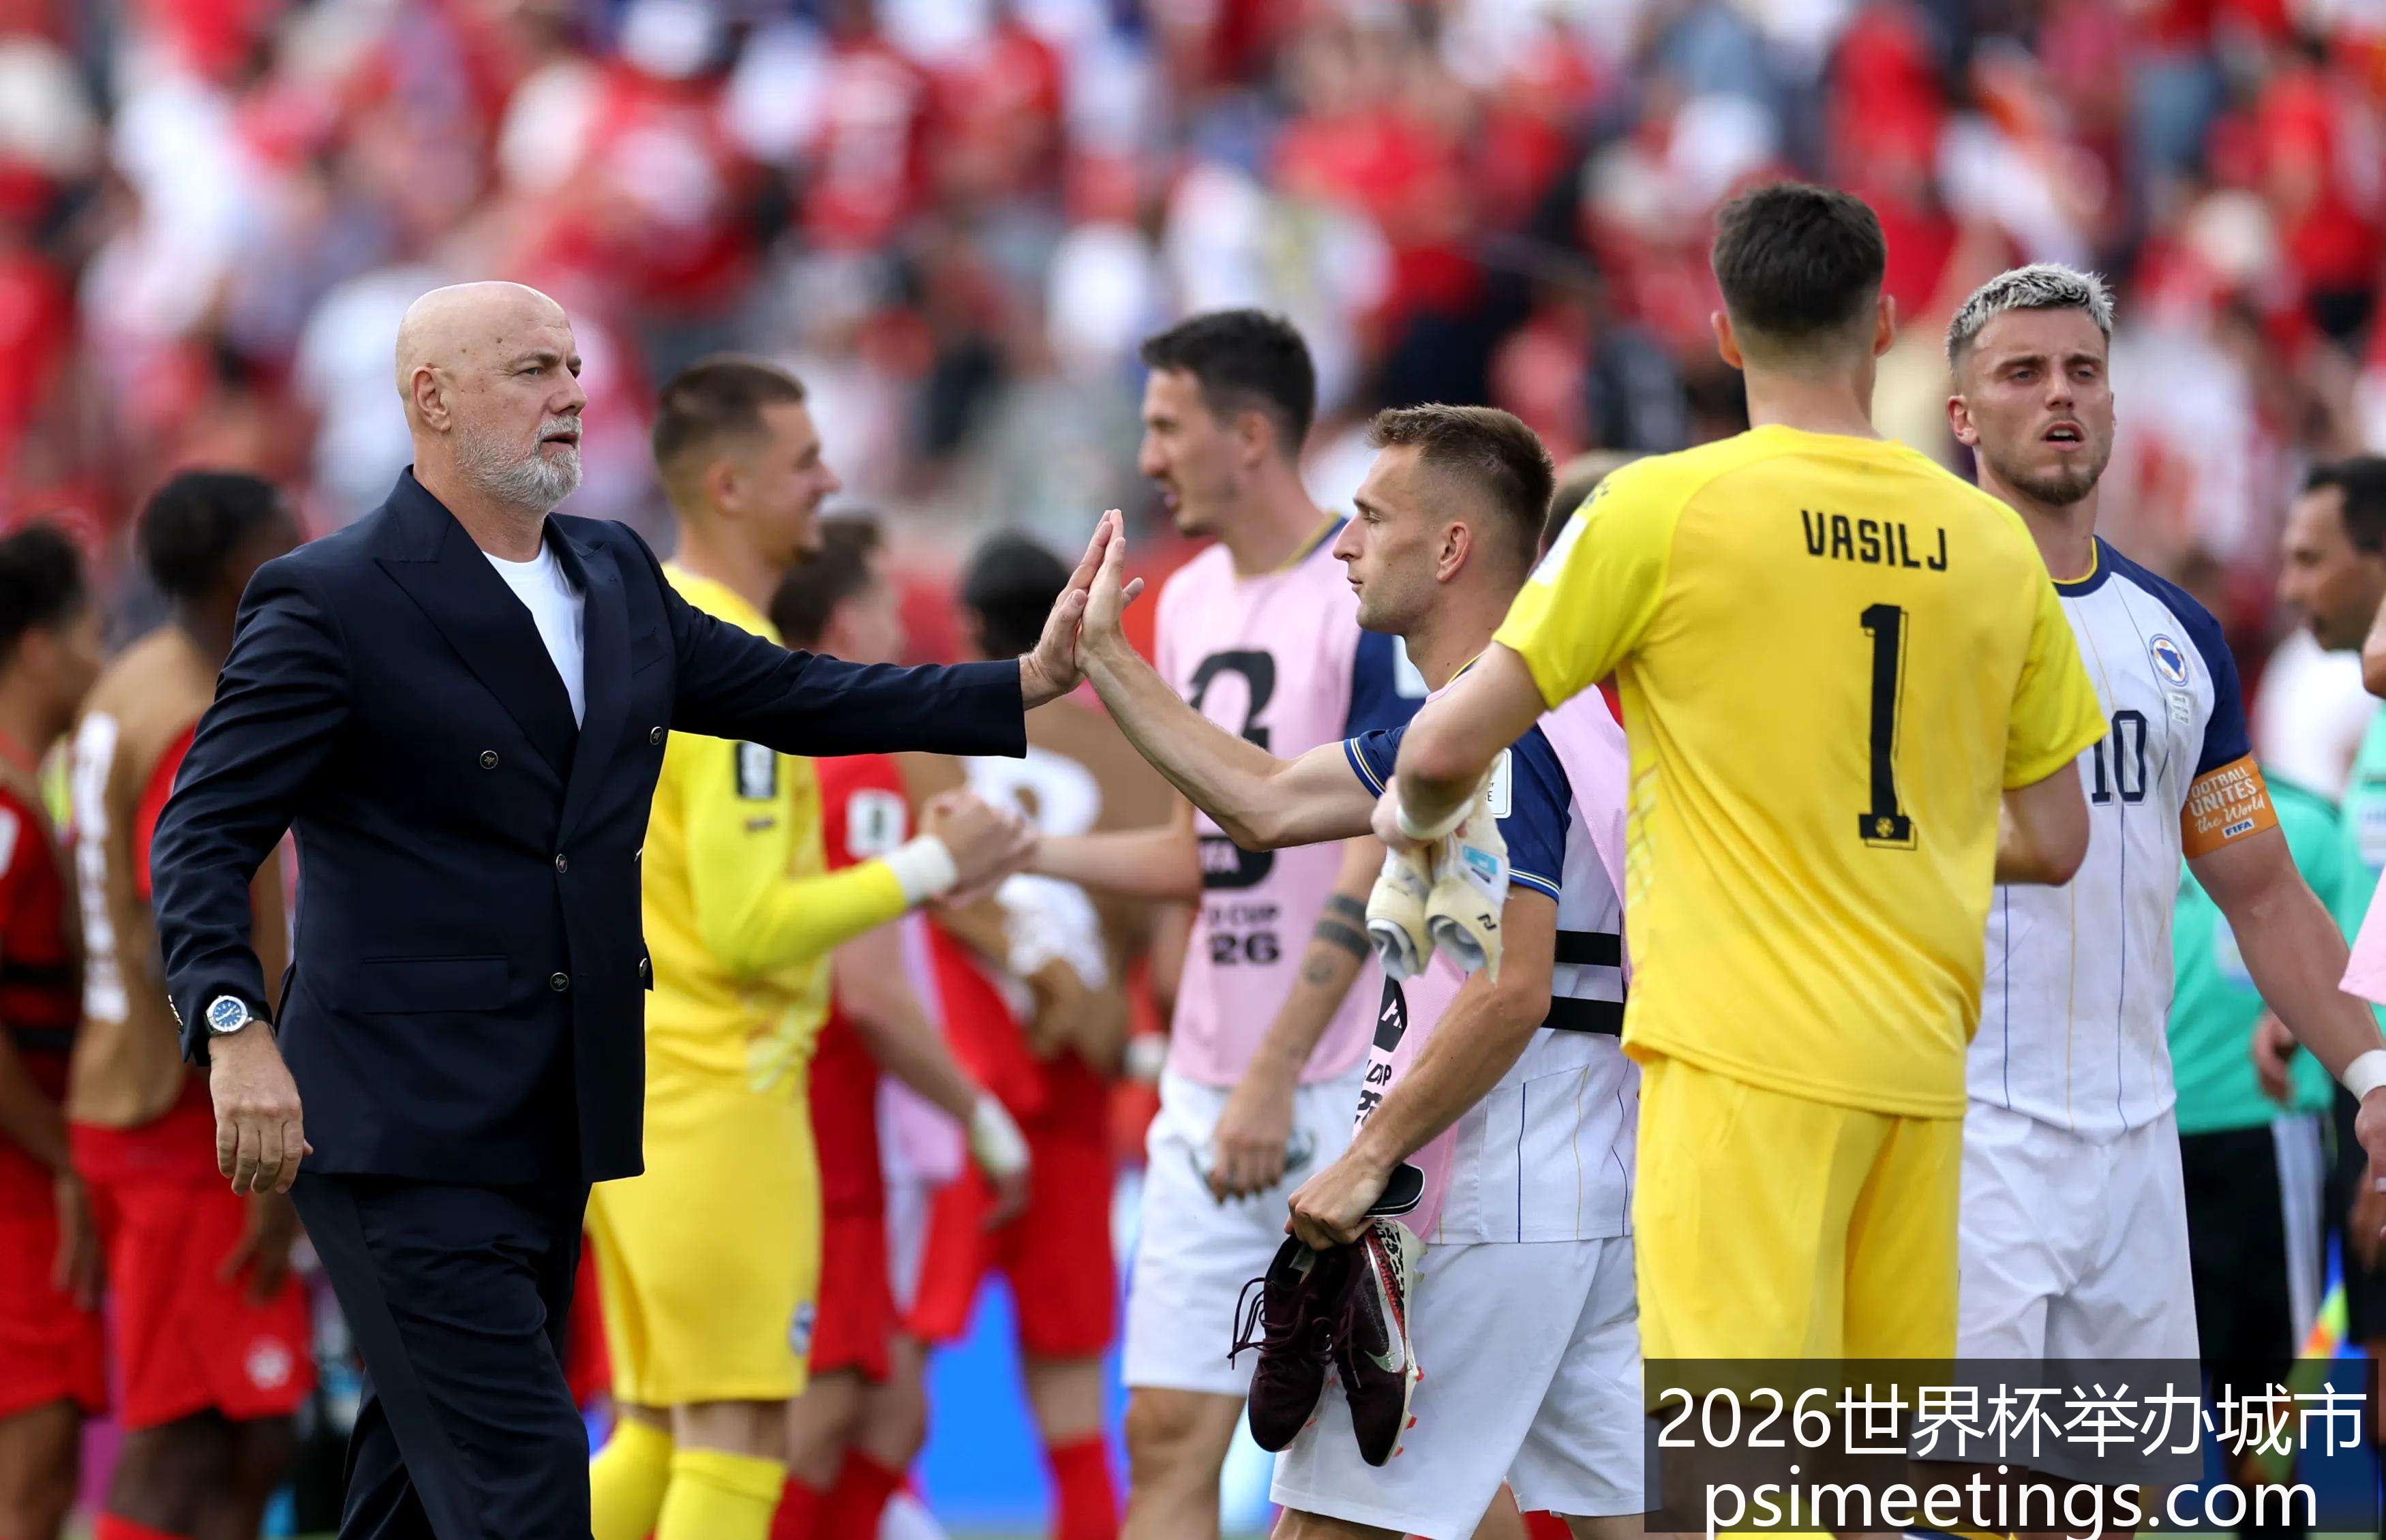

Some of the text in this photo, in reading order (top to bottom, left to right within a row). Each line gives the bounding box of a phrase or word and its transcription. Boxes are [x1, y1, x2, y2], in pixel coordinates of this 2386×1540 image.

[1801, 510, 1947, 572] VASILJ
[1858, 603, 1913, 847] 1
[2092, 710, 2147, 803] 10
[2189, 778, 2257, 817] UNITES
[2190, 766, 2250, 797] OOTBALL
[2195, 794, 2265, 833] the World
[2224, 820, 2253, 837] FIFA
[1210, 932, 1280, 965] 26
